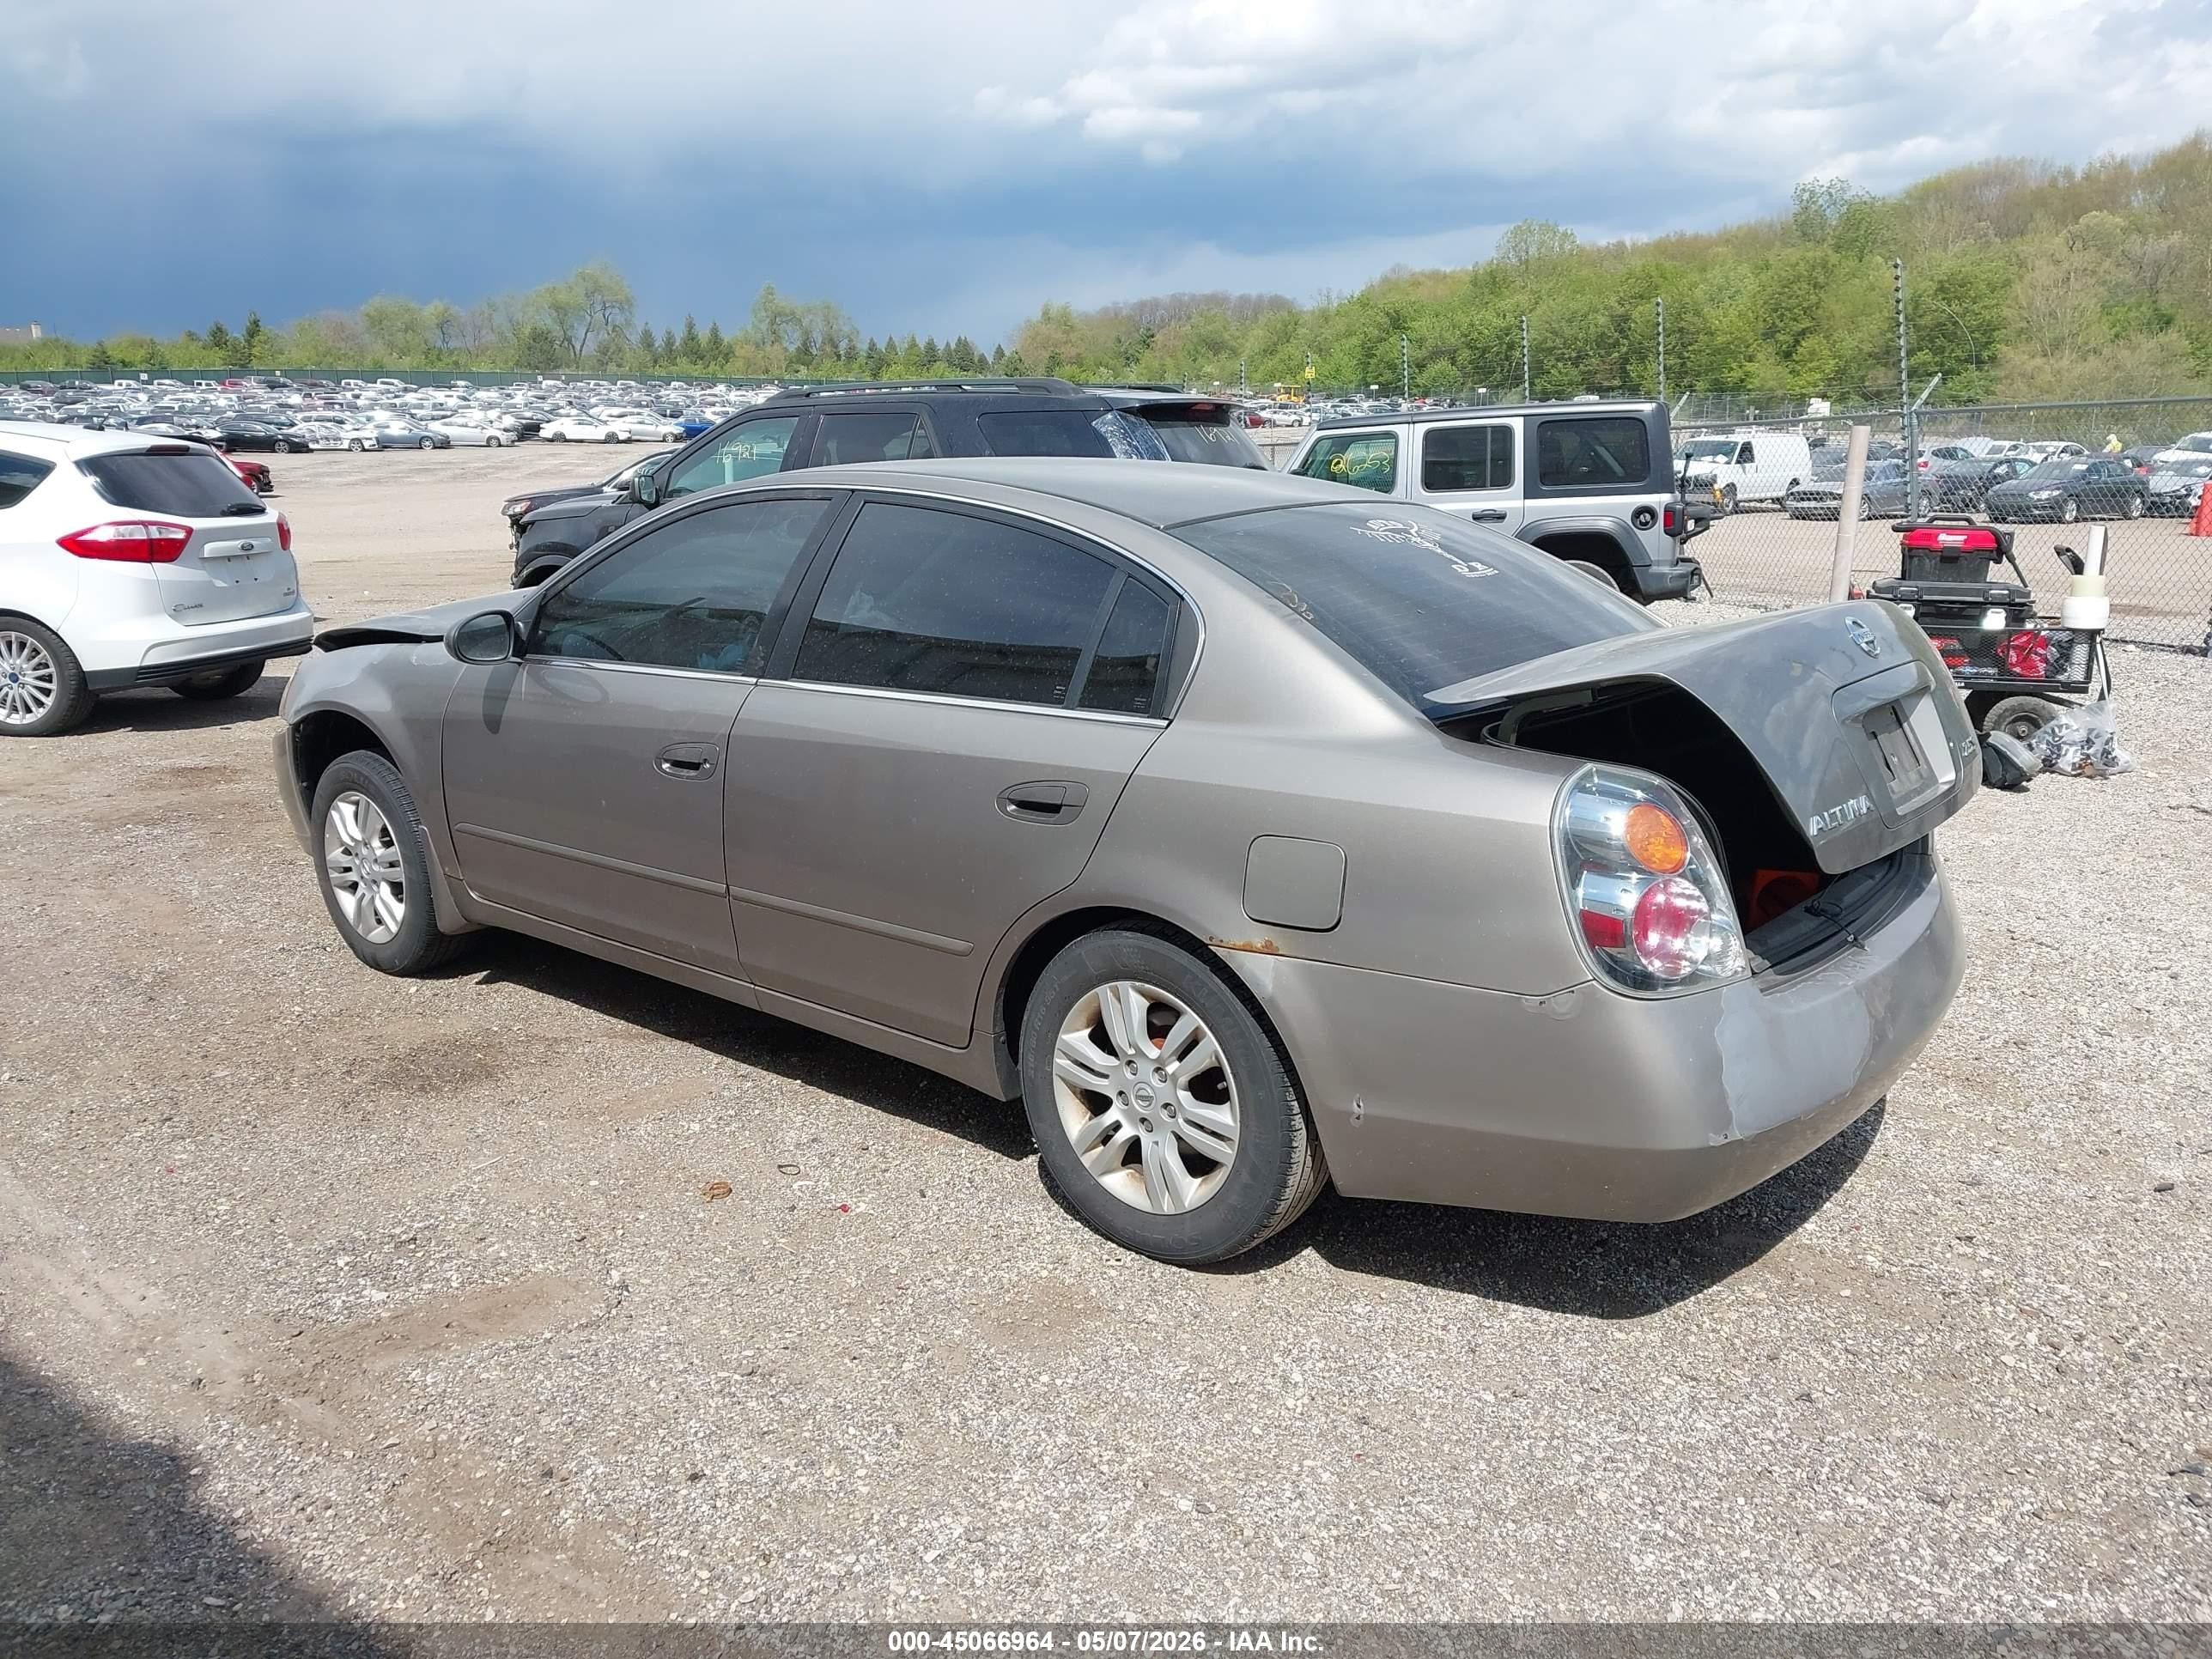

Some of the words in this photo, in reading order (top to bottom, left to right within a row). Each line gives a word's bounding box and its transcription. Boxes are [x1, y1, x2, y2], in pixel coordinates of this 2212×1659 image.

[1194, 424, 1240, 445] 16921
[716, 440, 757, 464] 16921
[1329, 451, 1390, 475] 26253
[1810, 794, 1875, 836] ALTIMA
